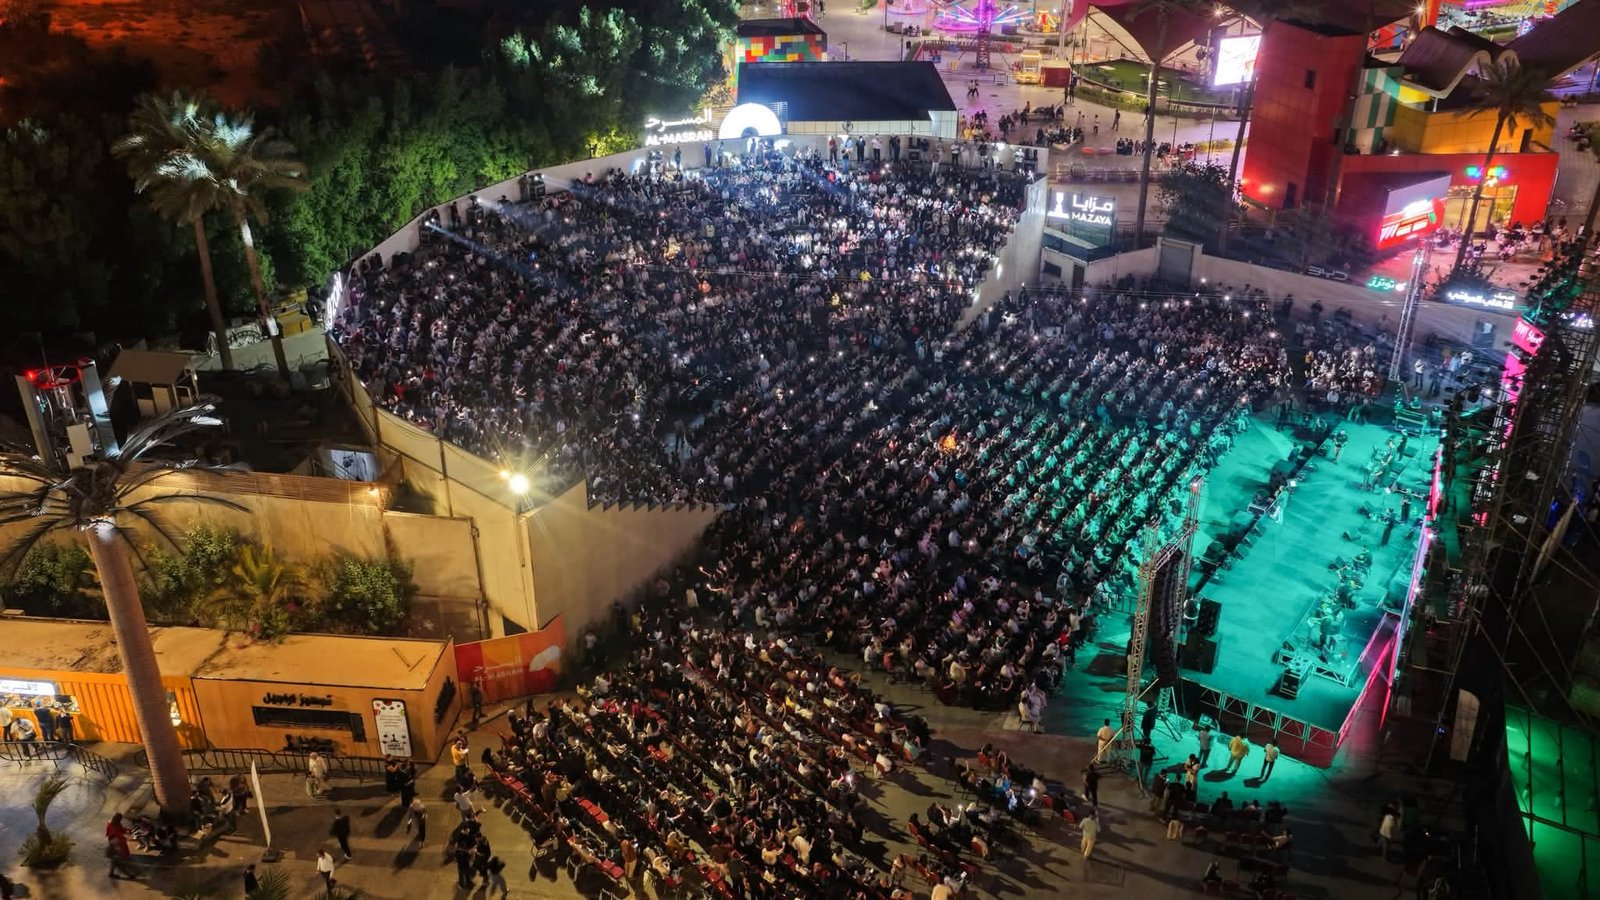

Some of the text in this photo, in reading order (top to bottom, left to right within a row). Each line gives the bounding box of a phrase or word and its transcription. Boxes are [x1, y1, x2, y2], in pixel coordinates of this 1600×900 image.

[645, 108, 712, 132] المسرح
[645, 130, 713, 146] AL-MASRAH
[1073, 194, 1113, 212] مزايا
[1072, 212, 1112, 225] MAZAYA
